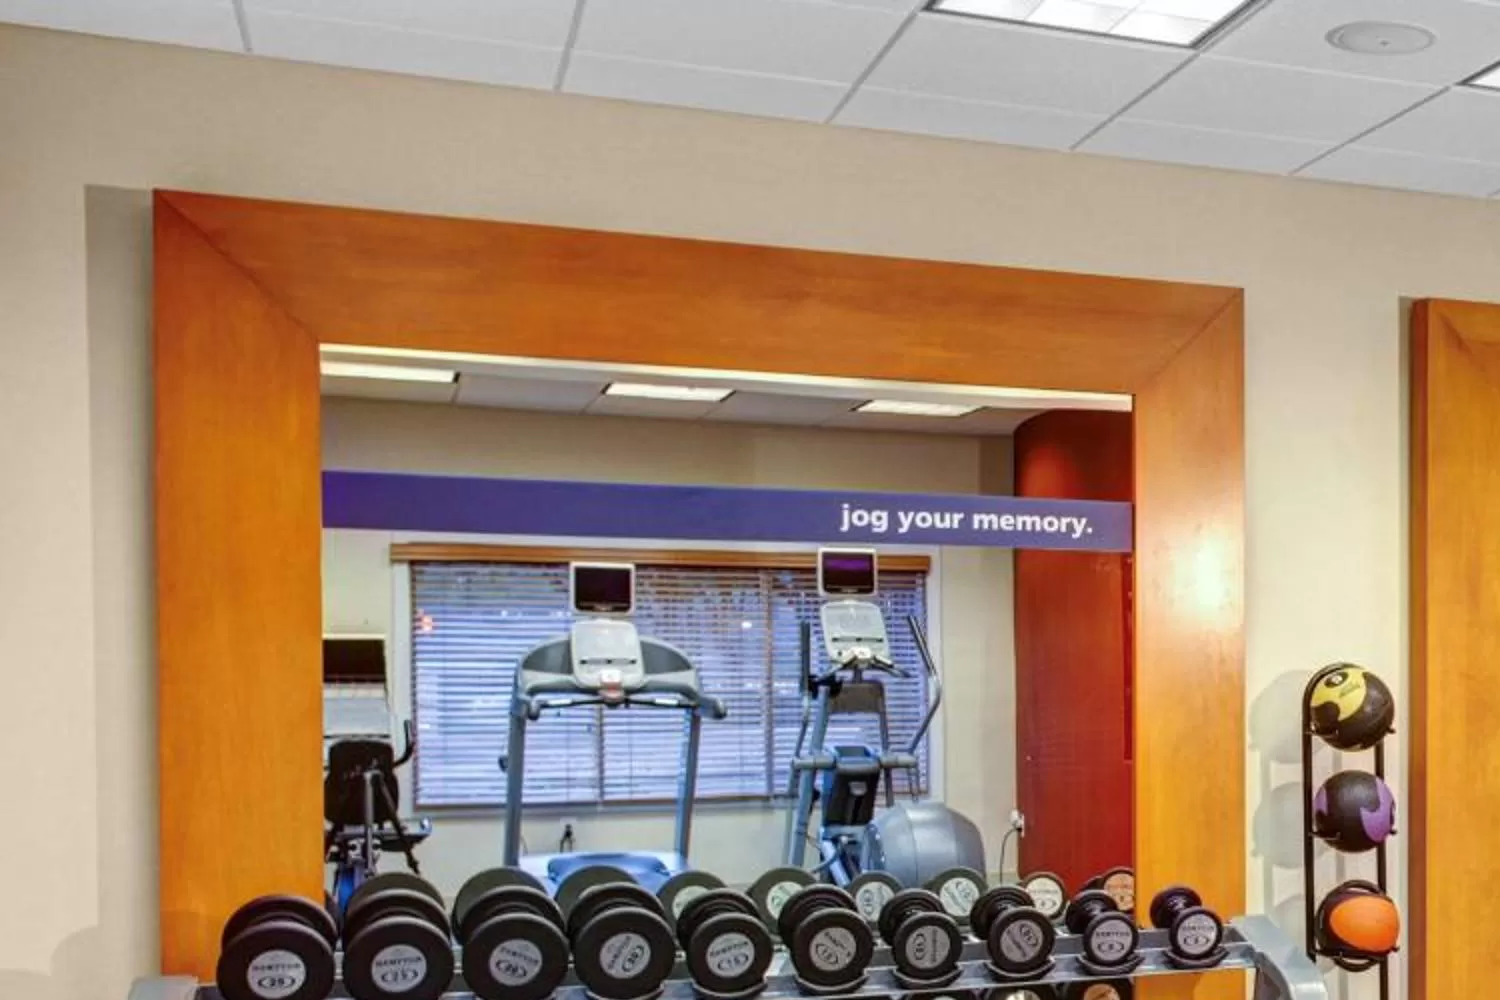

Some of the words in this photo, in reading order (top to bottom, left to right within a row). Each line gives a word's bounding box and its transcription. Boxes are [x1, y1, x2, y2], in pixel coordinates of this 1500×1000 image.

[840, 503, 889, 533] jog
[897, 510, 965, 534] your
[972, 512, 1093, 539] memory.
